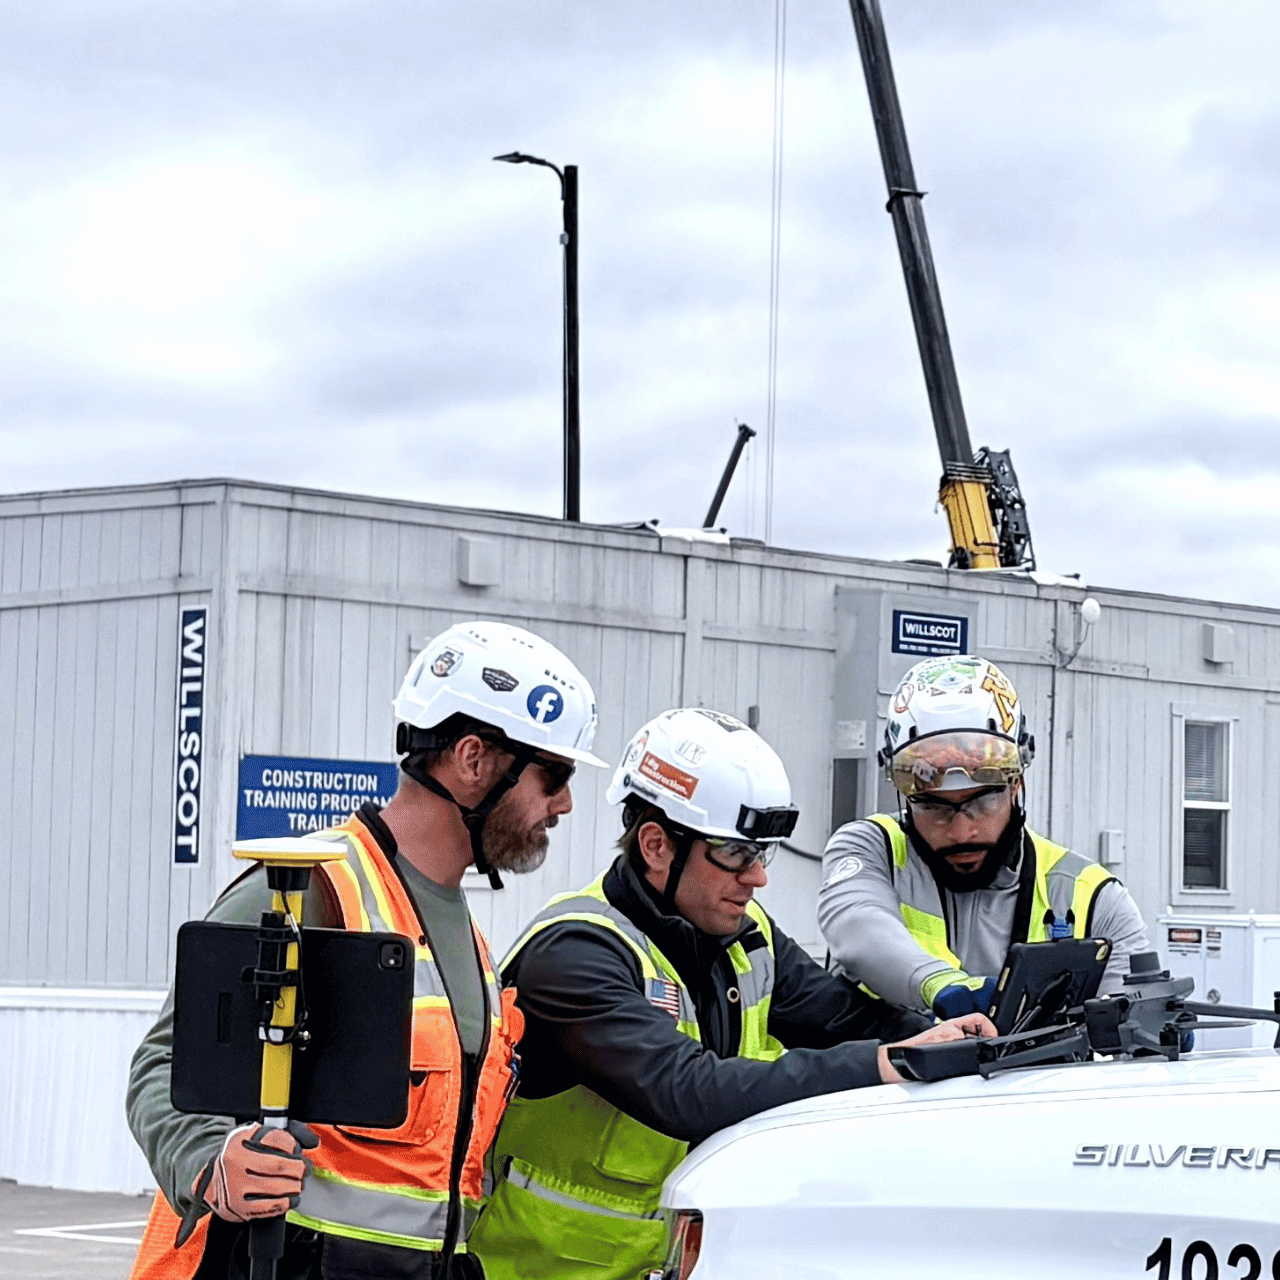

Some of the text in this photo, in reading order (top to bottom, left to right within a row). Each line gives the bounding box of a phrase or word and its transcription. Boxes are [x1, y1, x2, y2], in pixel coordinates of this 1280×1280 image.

[905, 622, 956, 639] WILLSCOT
[177, 617, 204, 855] WILLSCOT
[262, 769, 378, 792] CONSTRUCTION
[244, 789, 318, 810] TRAINING
